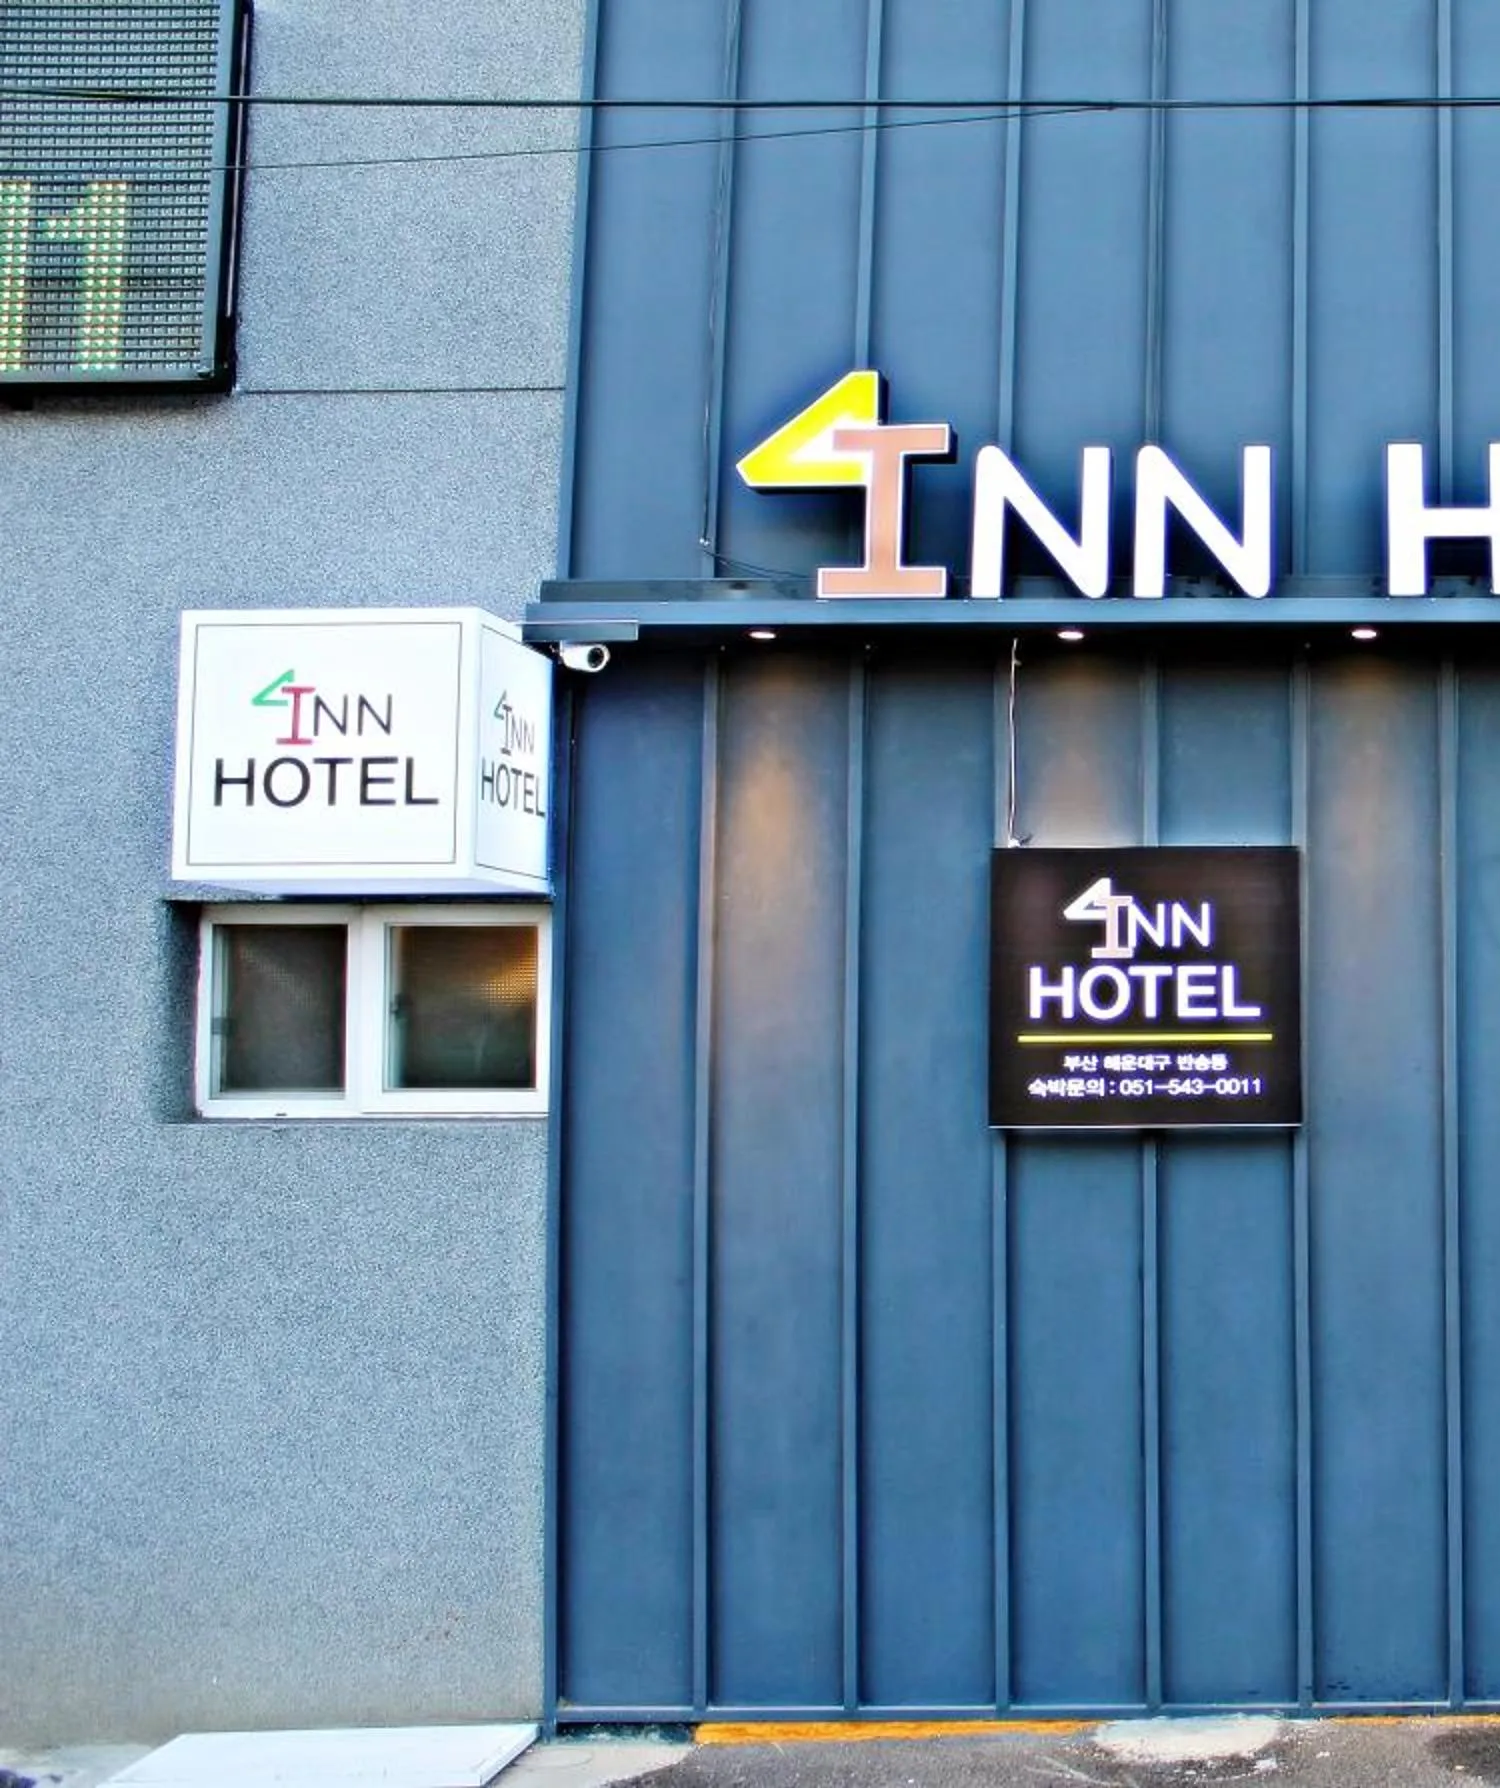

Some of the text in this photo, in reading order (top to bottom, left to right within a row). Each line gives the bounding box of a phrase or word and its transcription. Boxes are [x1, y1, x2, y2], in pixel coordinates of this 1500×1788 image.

[213, 756, 440, 808] HOTEL
[481, 757, 546, 818] HOTEL
[1029, 965, 1261, 1020] HOTEL
[1063, 1055, 1099, 1072] 부산
[1119, 1078, 1262, 1096] 051-543-0011
